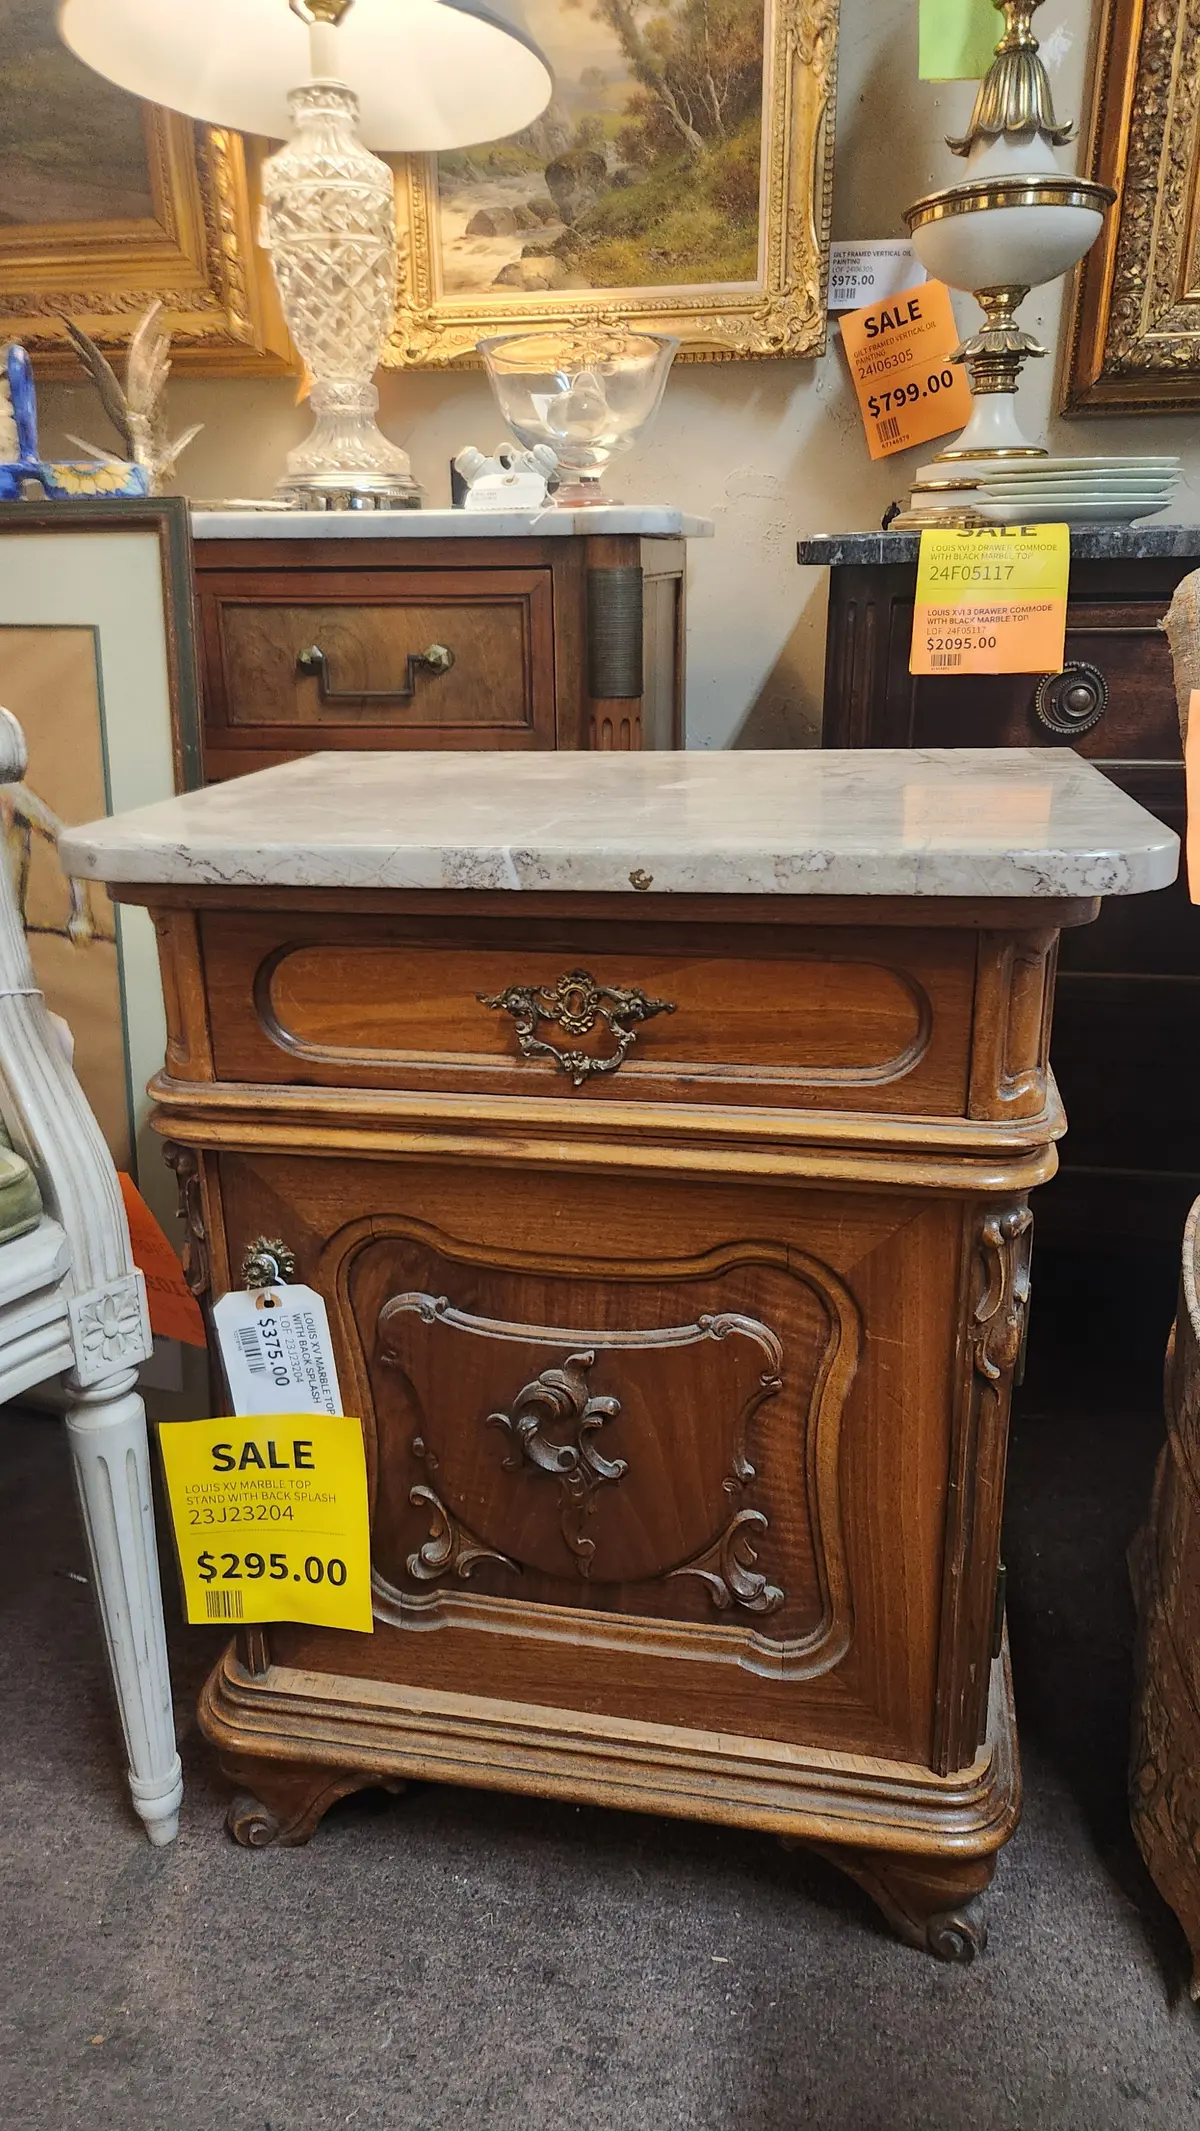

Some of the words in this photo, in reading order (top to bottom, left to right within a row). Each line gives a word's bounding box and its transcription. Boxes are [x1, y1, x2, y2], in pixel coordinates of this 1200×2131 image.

[831, 275, 875, 287] $975.00
[864, 299, 922, 338] SALE
[853, 348, 868, 359] GILT
[868, 337, 895, 352] FRAMED
[895, 327, 925, 342] VERTICAL
[925, 321, 937, 330] OIL
[855, 350, 886, 366] PAINTING
[868, 369, 953, 419] $799.00
[931, 544, 956, 552] LOUIS
[1017, 552, 1034, 560] TOP
[929, 566, 1014, 581] 24F05117
[927, 609, 950, 617] LOUIS
[1010, 604, 1052, 614] COMMODE
[949, 617, 976, 625] BLACK
[977, 615, 1010, 623] MARBLE
[946, 626, 986, 635] 24F05117
[926, 636, 996, 652] $2095.00
[292, 1313, 306, 1338] WITH
[303, 1312, 317, 1340] LOUIS
[257, 1318, 290, 1386] $375.00
[299, 1340, 312, 1366] BACK
[310, 1342, 321, 1355] XV
[285, 1339, 304, 1383] 23J23204
[314, 1356, 331, 1395] MARBLE
[305, 1368, 321, 1404] SPLASH
[324, 1397, 336, 1415] TOP
[211, 1440, 315, 1472] SALE
[185, 1483, 220, 1494] LOUIS
[223, 1482, 237, 1491] XV
[240, 1480, 286, 1490] MARBLE
[288, 1480, 311, 1489] TOP
[186, 1494, 225, 1506] STAND
[228, 1492, 258, 1502] WITH
[261, 1491, 291, 1501] BACK
[294, 1491, 336, 1503] SPLASH
[188, 1504, 294, 1525] 23J23204
[197, 1551, 348, 1586] $295.00
